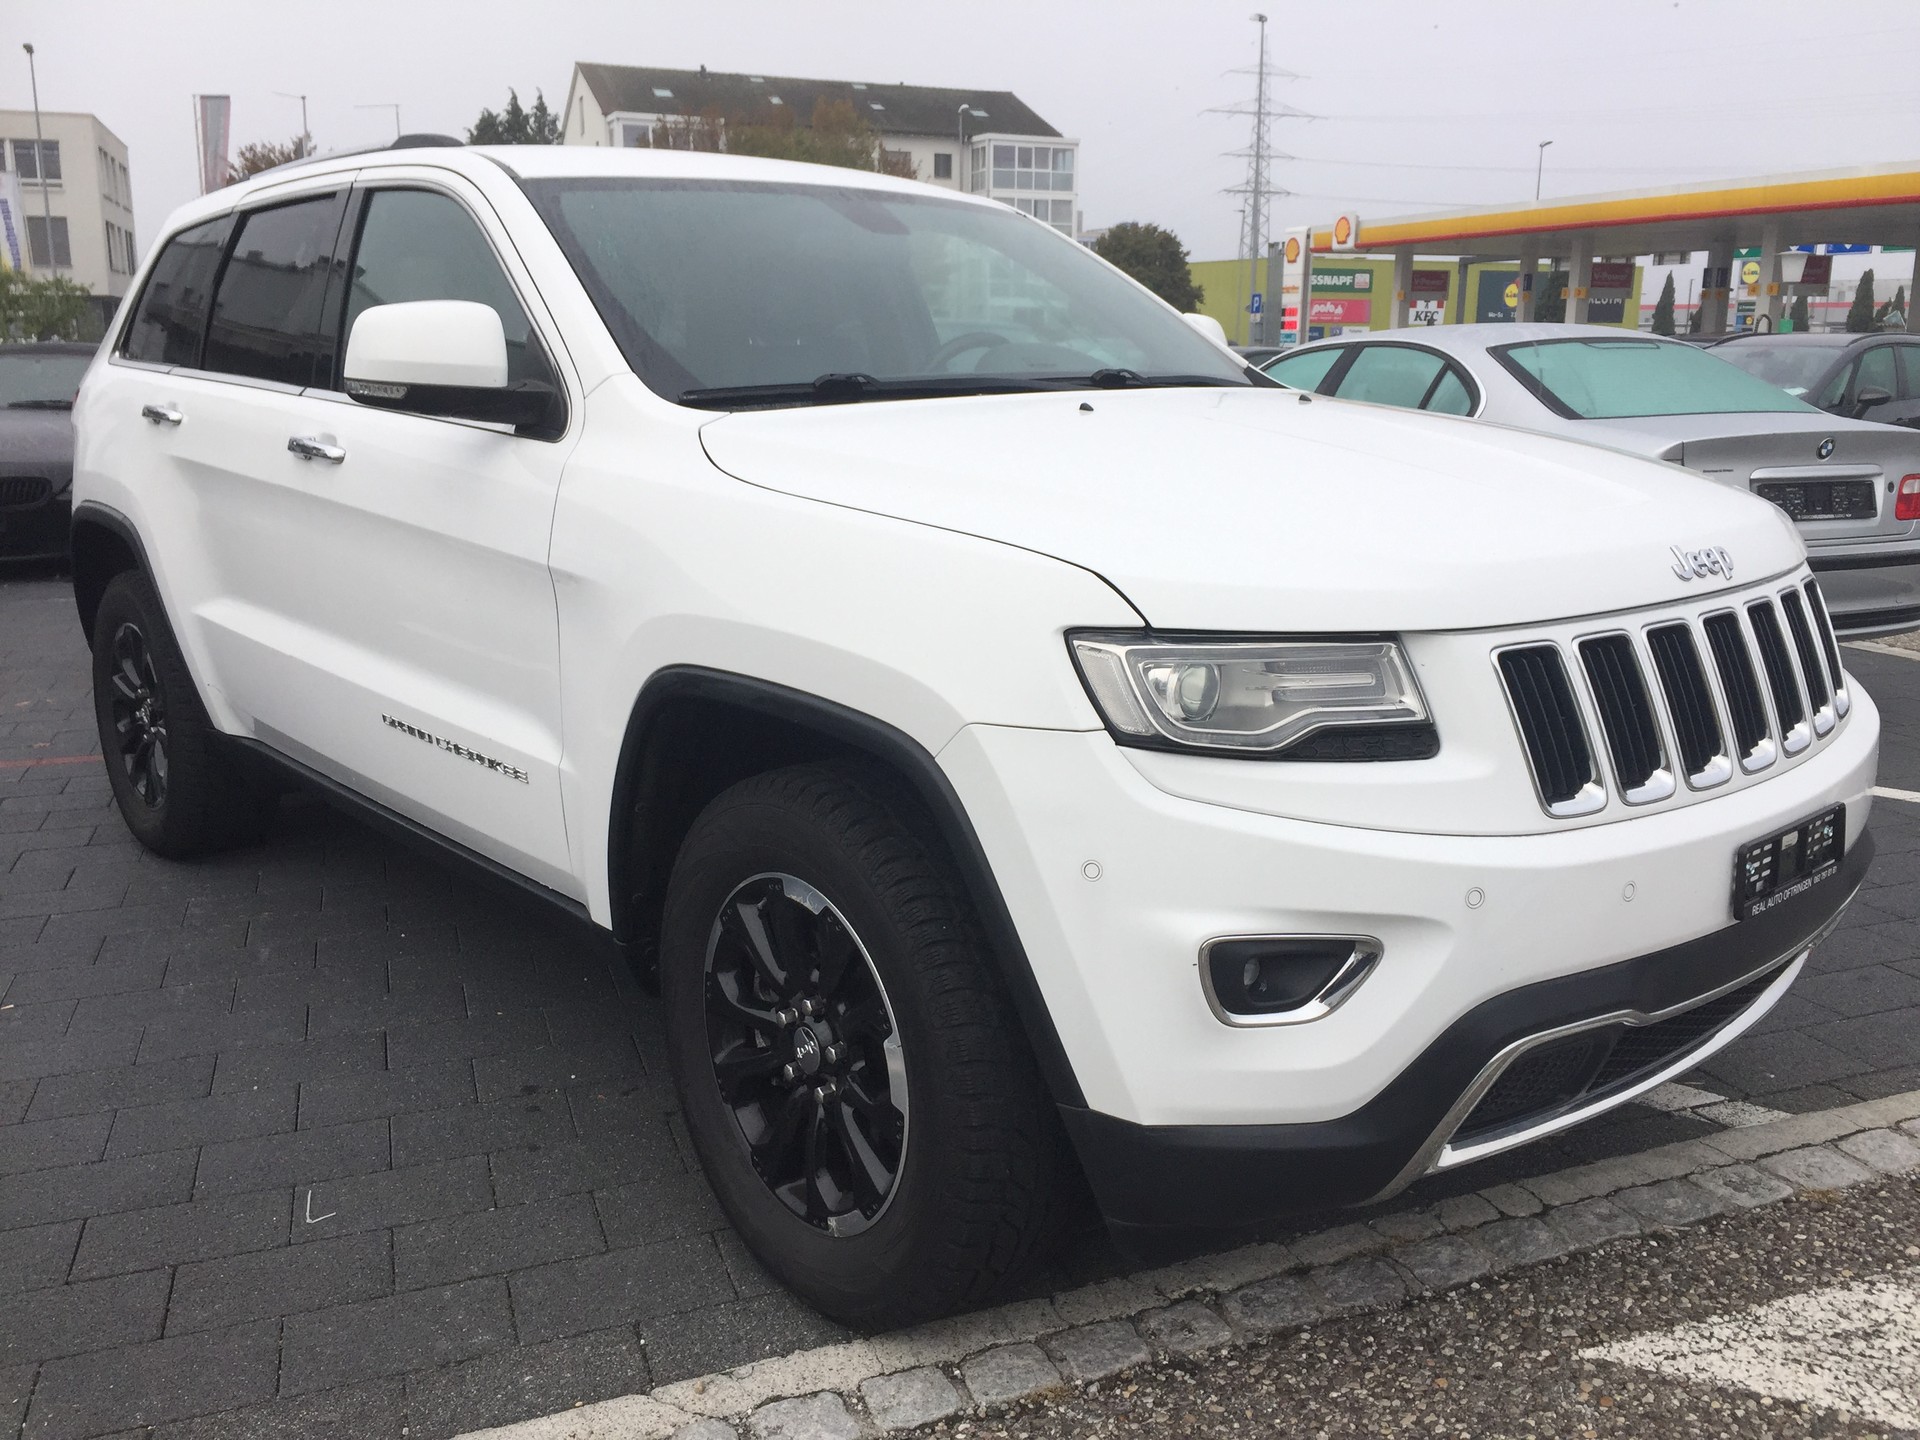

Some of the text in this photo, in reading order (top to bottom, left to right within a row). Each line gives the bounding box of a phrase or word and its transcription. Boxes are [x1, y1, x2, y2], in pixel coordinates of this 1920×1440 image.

[1253, 296, 1260, 312] P
[1413, 310, 1439, 321] KFC
[1669, 544, 1734, 582] Jeep
[1751, 900, 1767, 916] REAL
[1767, 892, 1783, 908] AUTO
[1783, 877, 1813, 901] OFTRINGEN
